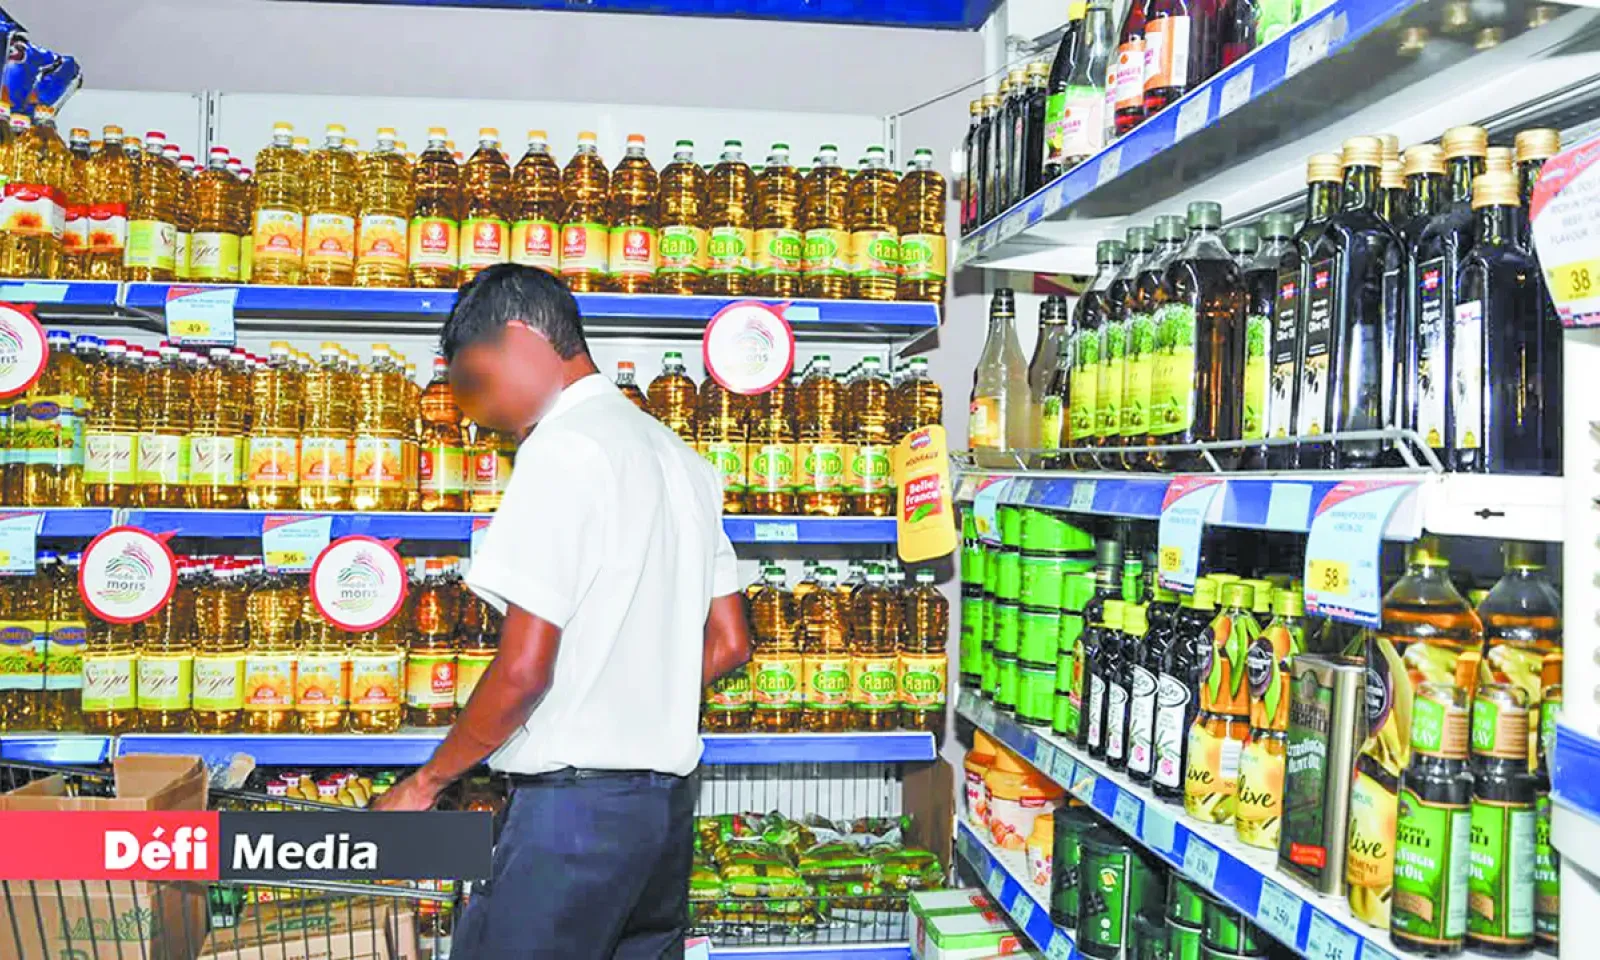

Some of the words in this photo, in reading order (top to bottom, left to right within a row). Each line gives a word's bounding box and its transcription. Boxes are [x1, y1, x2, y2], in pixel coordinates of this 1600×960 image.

[661, 239, 692, 252] Rani
[708, 238, 739, 253] Rani
[775, 239, 800, 256] Ran
[1570, 267, 1592, 292] 38
[187, 323, 202, 333] 49
[909, 479, 935, 495] Belle
[284, 553, 298, 565] 56
[106, 579, 146, 591] moris
[1325, 567, 1340, 588] 58
[341, 588, 378, 598] moris
[760, 674, 790, 689] Rani
[817, 675, 849, 690] Rani
[863, 676, 894, 691] Rani
[905, 676, 936, 691] Rani
[1188, 766, 1215, 785] ive
[1348, 819, 1387, 859] live
